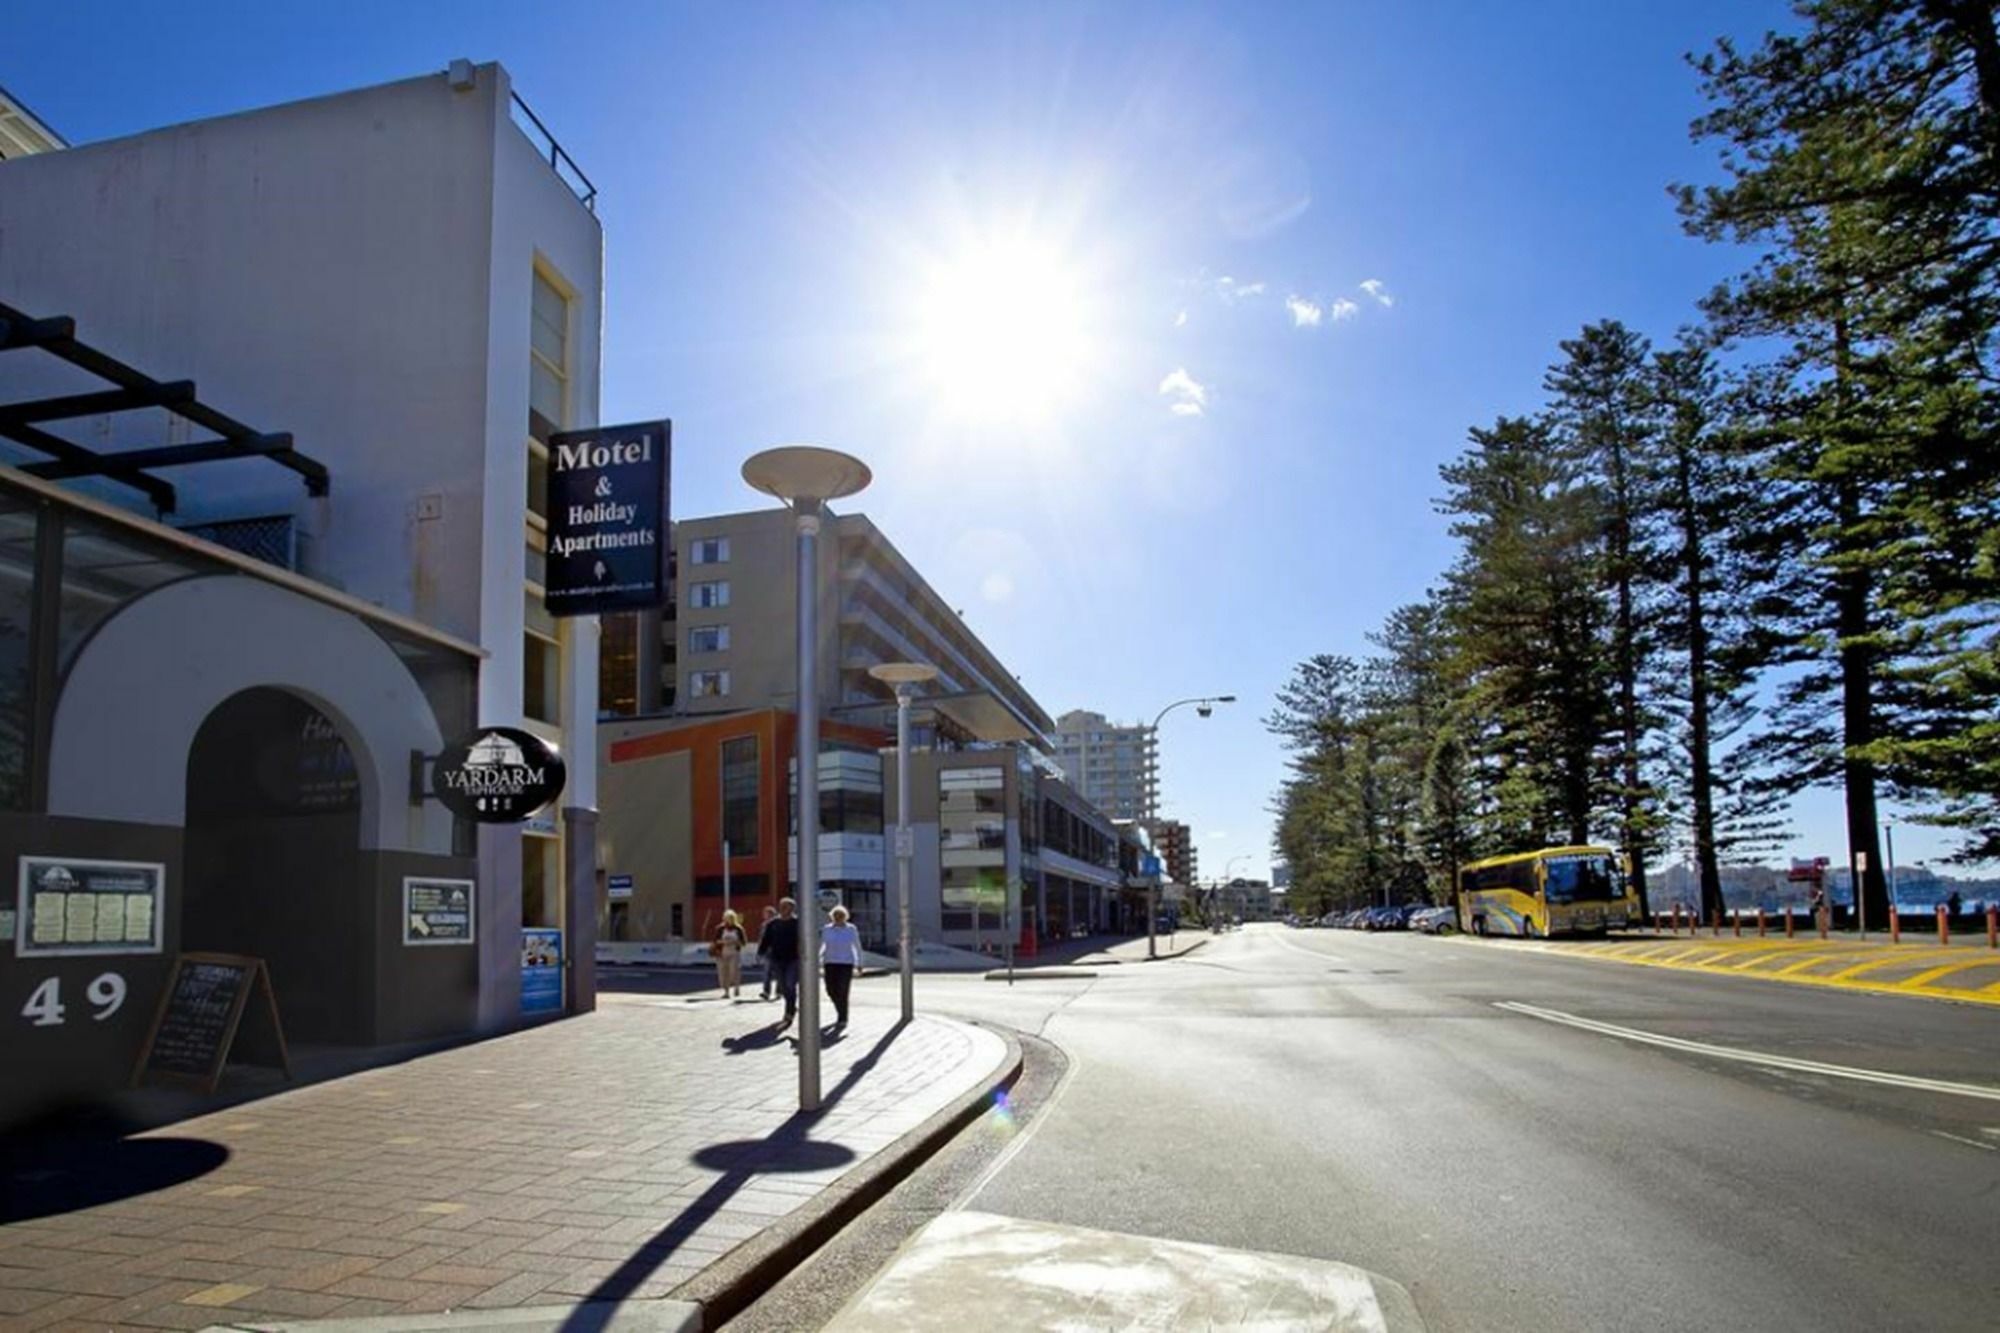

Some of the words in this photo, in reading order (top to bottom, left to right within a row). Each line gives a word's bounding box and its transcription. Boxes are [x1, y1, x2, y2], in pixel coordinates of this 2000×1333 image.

[556, 435, 651, 472] Motel
[595, 475, 613, 497] &
[568, 502, 637, 526] Holiday
[550, 528, 656, 558] Apartments
[444, 767, 546, 788] YARDARM
